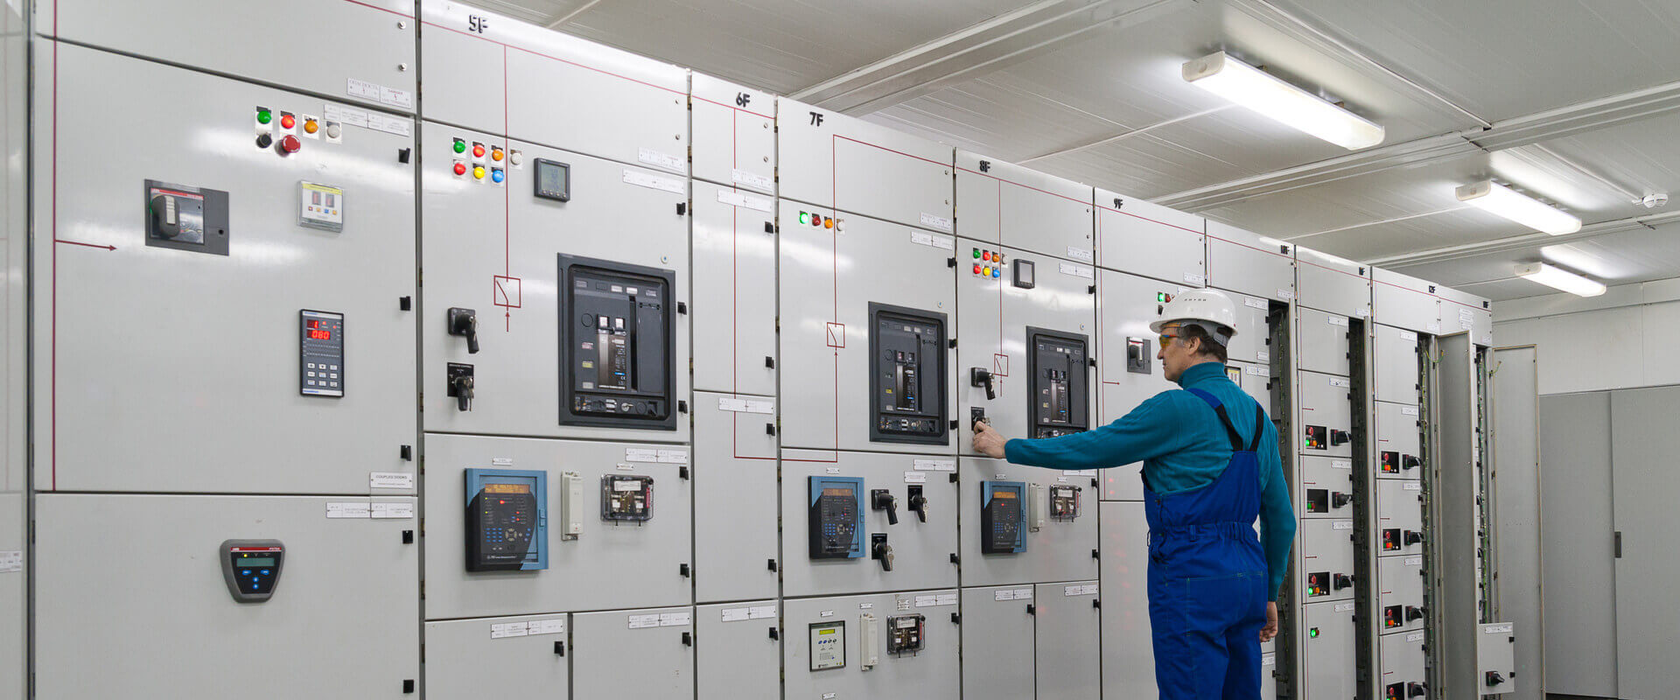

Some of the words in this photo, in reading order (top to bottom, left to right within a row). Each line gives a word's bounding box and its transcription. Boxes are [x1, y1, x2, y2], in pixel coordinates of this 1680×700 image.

[468, 14, 488, 34] 5F
[735, 91, 751, 108] 6F
[809, 111, 824, 127] 7F
[979, 160, 991, 173] 8F
[1113, 198, 1123, 209] 9F
